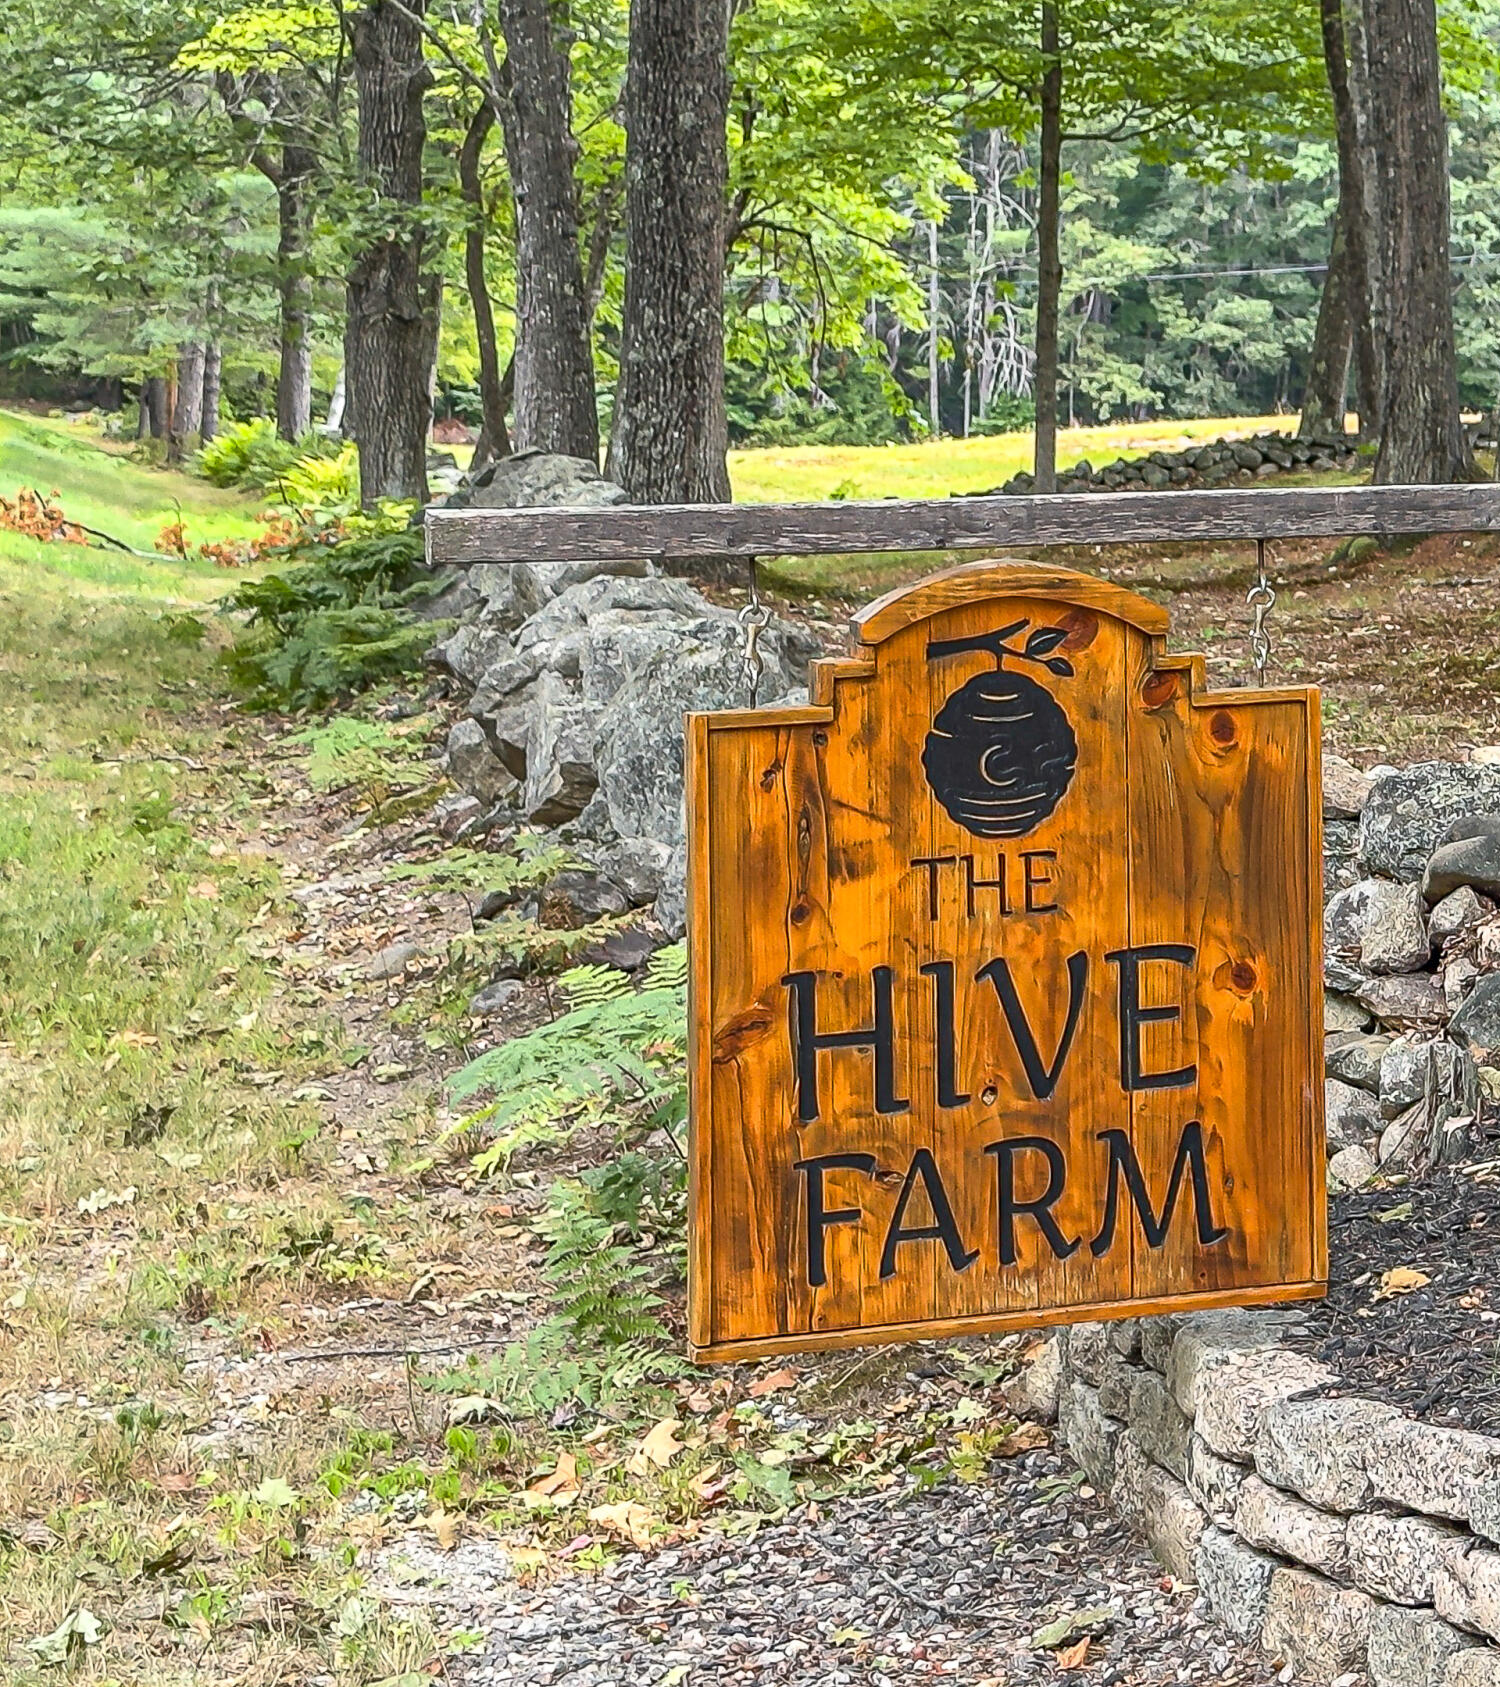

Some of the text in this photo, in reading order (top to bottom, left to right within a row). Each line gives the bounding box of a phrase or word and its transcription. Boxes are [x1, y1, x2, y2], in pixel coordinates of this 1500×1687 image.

[911, 850, 1059, 920] THE
[781, 945, 1198, 1121] HIVE
[794, 1122, 1227, 1286] FARM
